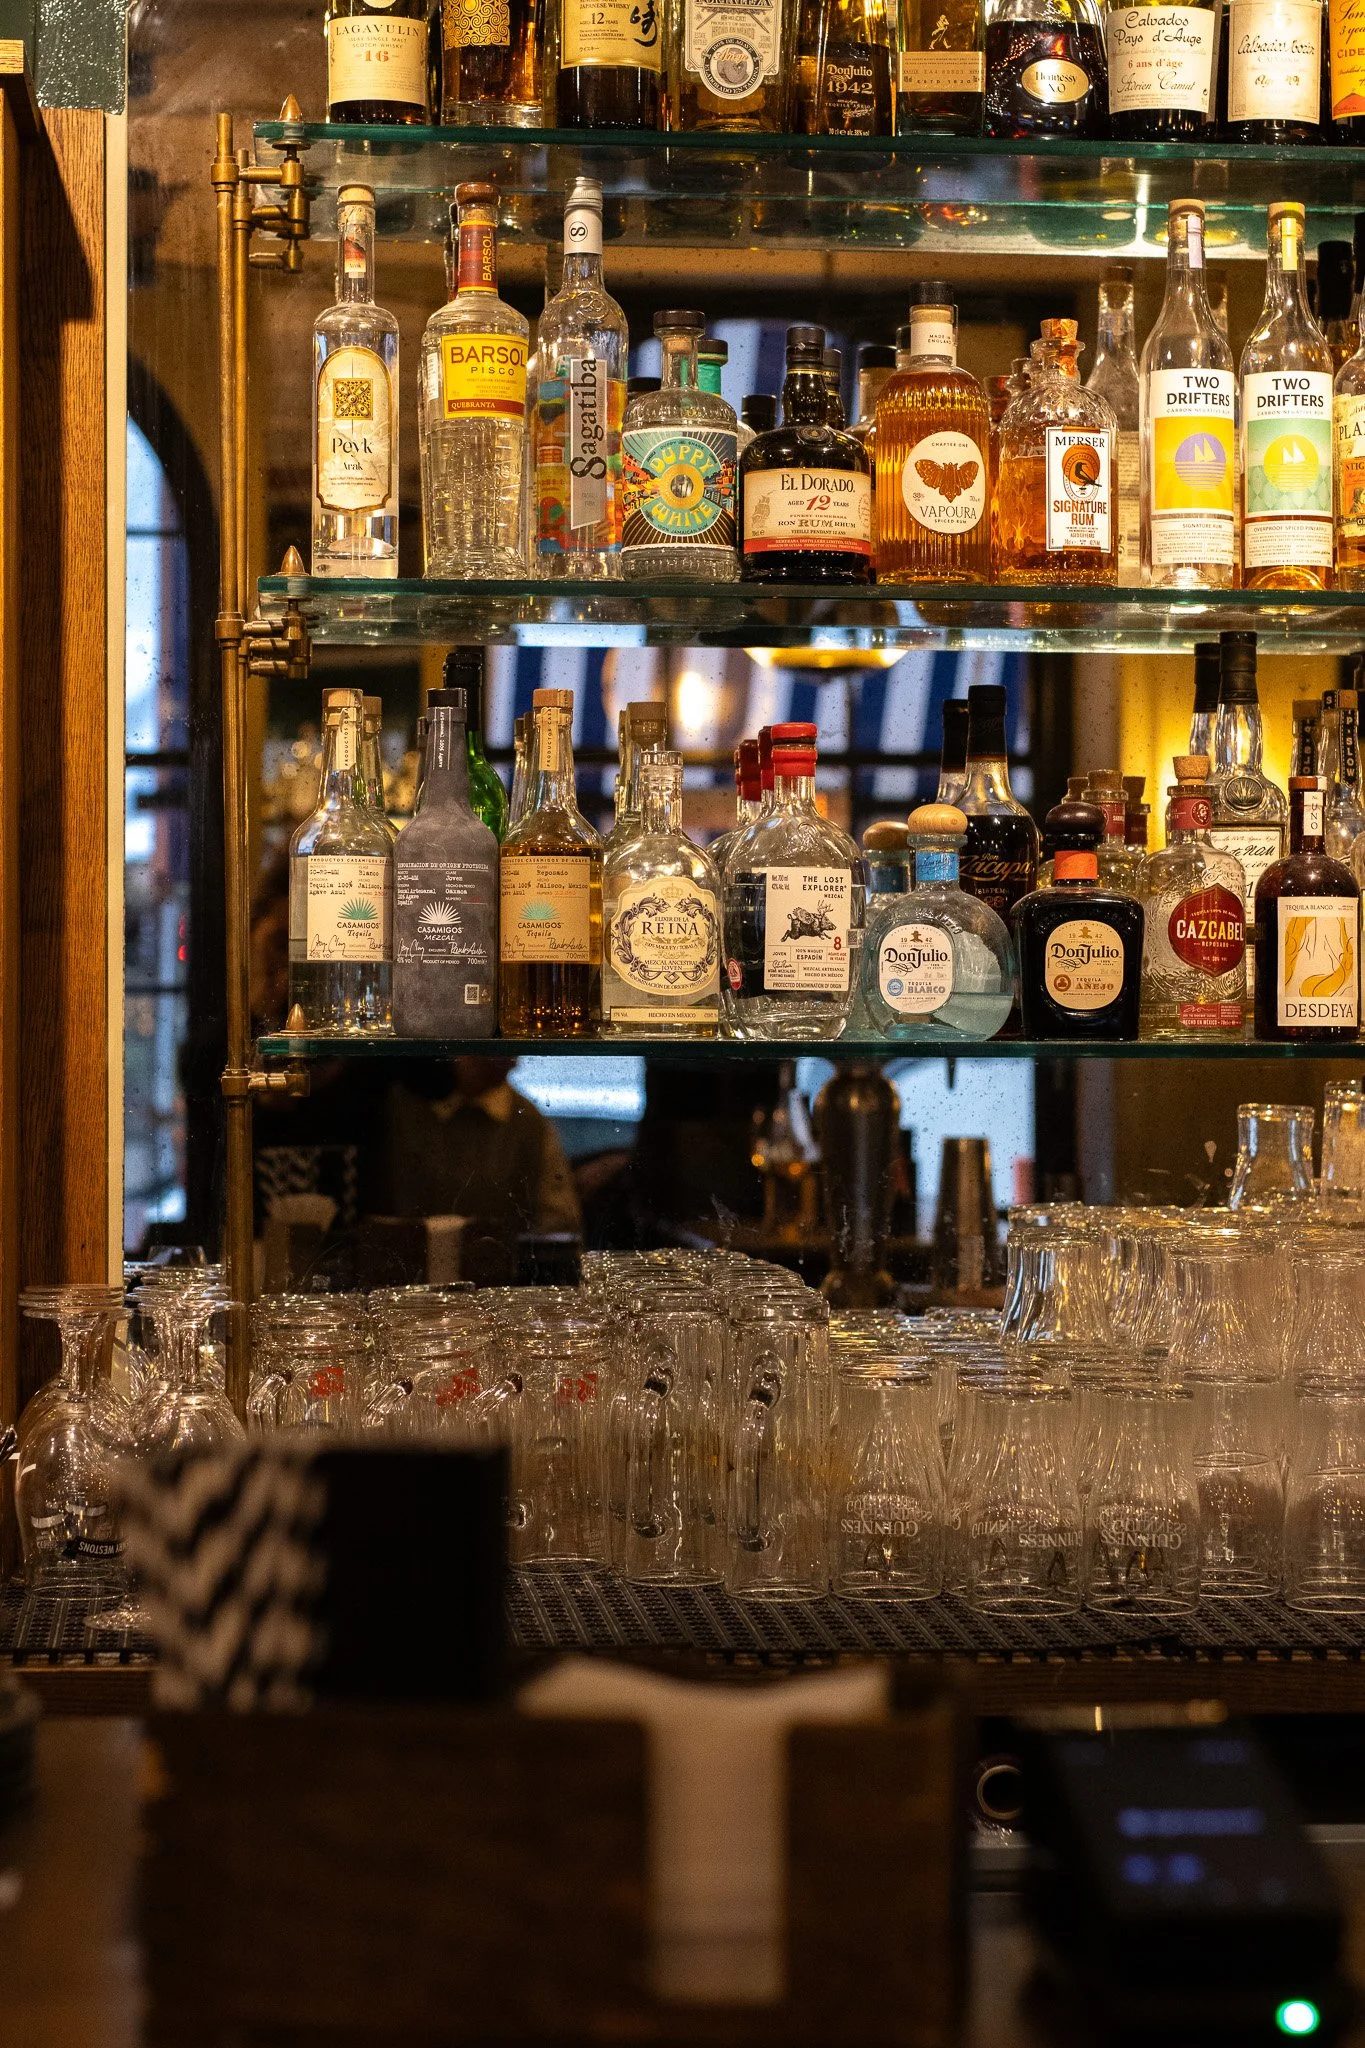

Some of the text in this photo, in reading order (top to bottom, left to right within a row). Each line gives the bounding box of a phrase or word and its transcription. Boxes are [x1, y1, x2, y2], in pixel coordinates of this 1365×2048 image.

[591, 12, 605, 25] 12
[1125, 11, 1189, 29] Calvados
[336, 24, 420, 37] LAGAVULIN
[1113, 27, 1202, 47] Pays d'Auge
[365, 50, 389, 62] 16
[1136, 60, 1153, 68] ans
[827, 81, 873, 95] 1942
[482, 233, 492, 282] BARSOL
[450, 345, 526, 368] BARSOL
[470, 366, 515, 376] PISCO
[1183, 375, 1220, 389] TWO
[1272, 378, 1311, 391] TWO
[451, 401, 496, 410] QUEBRANTA
[1166, 392, 1230, 407] DRIFTERS
[1257, 394, 1324, 408] DRIFTERS
[570, 357, 607, 480] Sagatiba
[1055, 436, 1106, 448] MERSER
[649, 445, 715, 474] DUPPY
[806, 494, 831, 511] 12
[1053, 499, 1107, 515] SIGNATURE
[651, 502, 713, 528] WHITE
[920, 505, 977, 520] VAPOURA
[1071, 513, 1095, 526] RUM
[797, 519, 834, 528] RUM
[1310, 803, 1318, 830] UNO
[824, 876, 844, 884] LOST
[802, 884, 844, 892] EXPLORER
[1286, 904, 1309, 912] TEQUILA
[336, 921, 379, 930] CASAMIGOS
[417, 926, 463, 934] CASAMIGOS
[641, 921, 699, 936] REINA
[1176, 919, 1244, 941] CAZCABEL
[347, 929, 372, 939] Tequila
[526, 929, 552, 939] Tequila
[833, 936, 842, 951] 8
[907, 986, 946, 994] BLANCO
[1285, 1003, 1354, 1018] DESDEYA
[840, 1518, 919, 1537] GUINNESS
[78, 1540, 115, 1555] WESTONS
